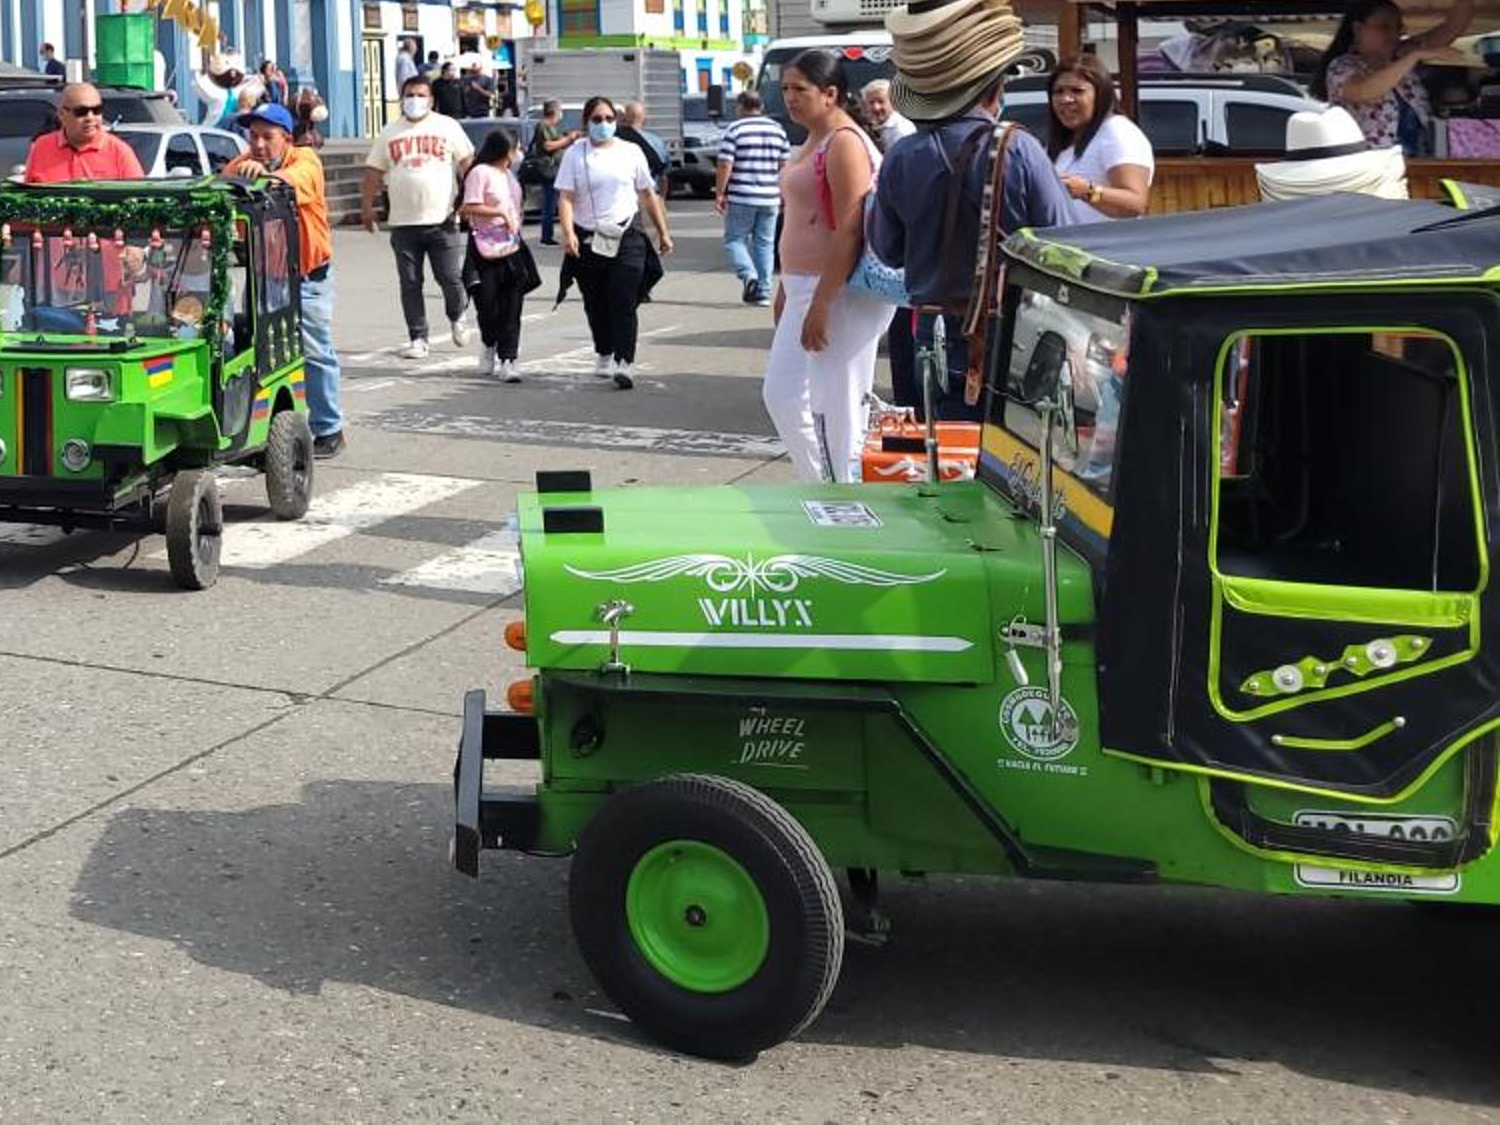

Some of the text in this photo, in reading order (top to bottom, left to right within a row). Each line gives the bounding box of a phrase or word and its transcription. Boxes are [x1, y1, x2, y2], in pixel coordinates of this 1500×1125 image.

[739, 717, 805, 737] WHEEL
[739, 739, 805, 764] DRIVE
[1340, 870, 1413, 886] FILANDIA
